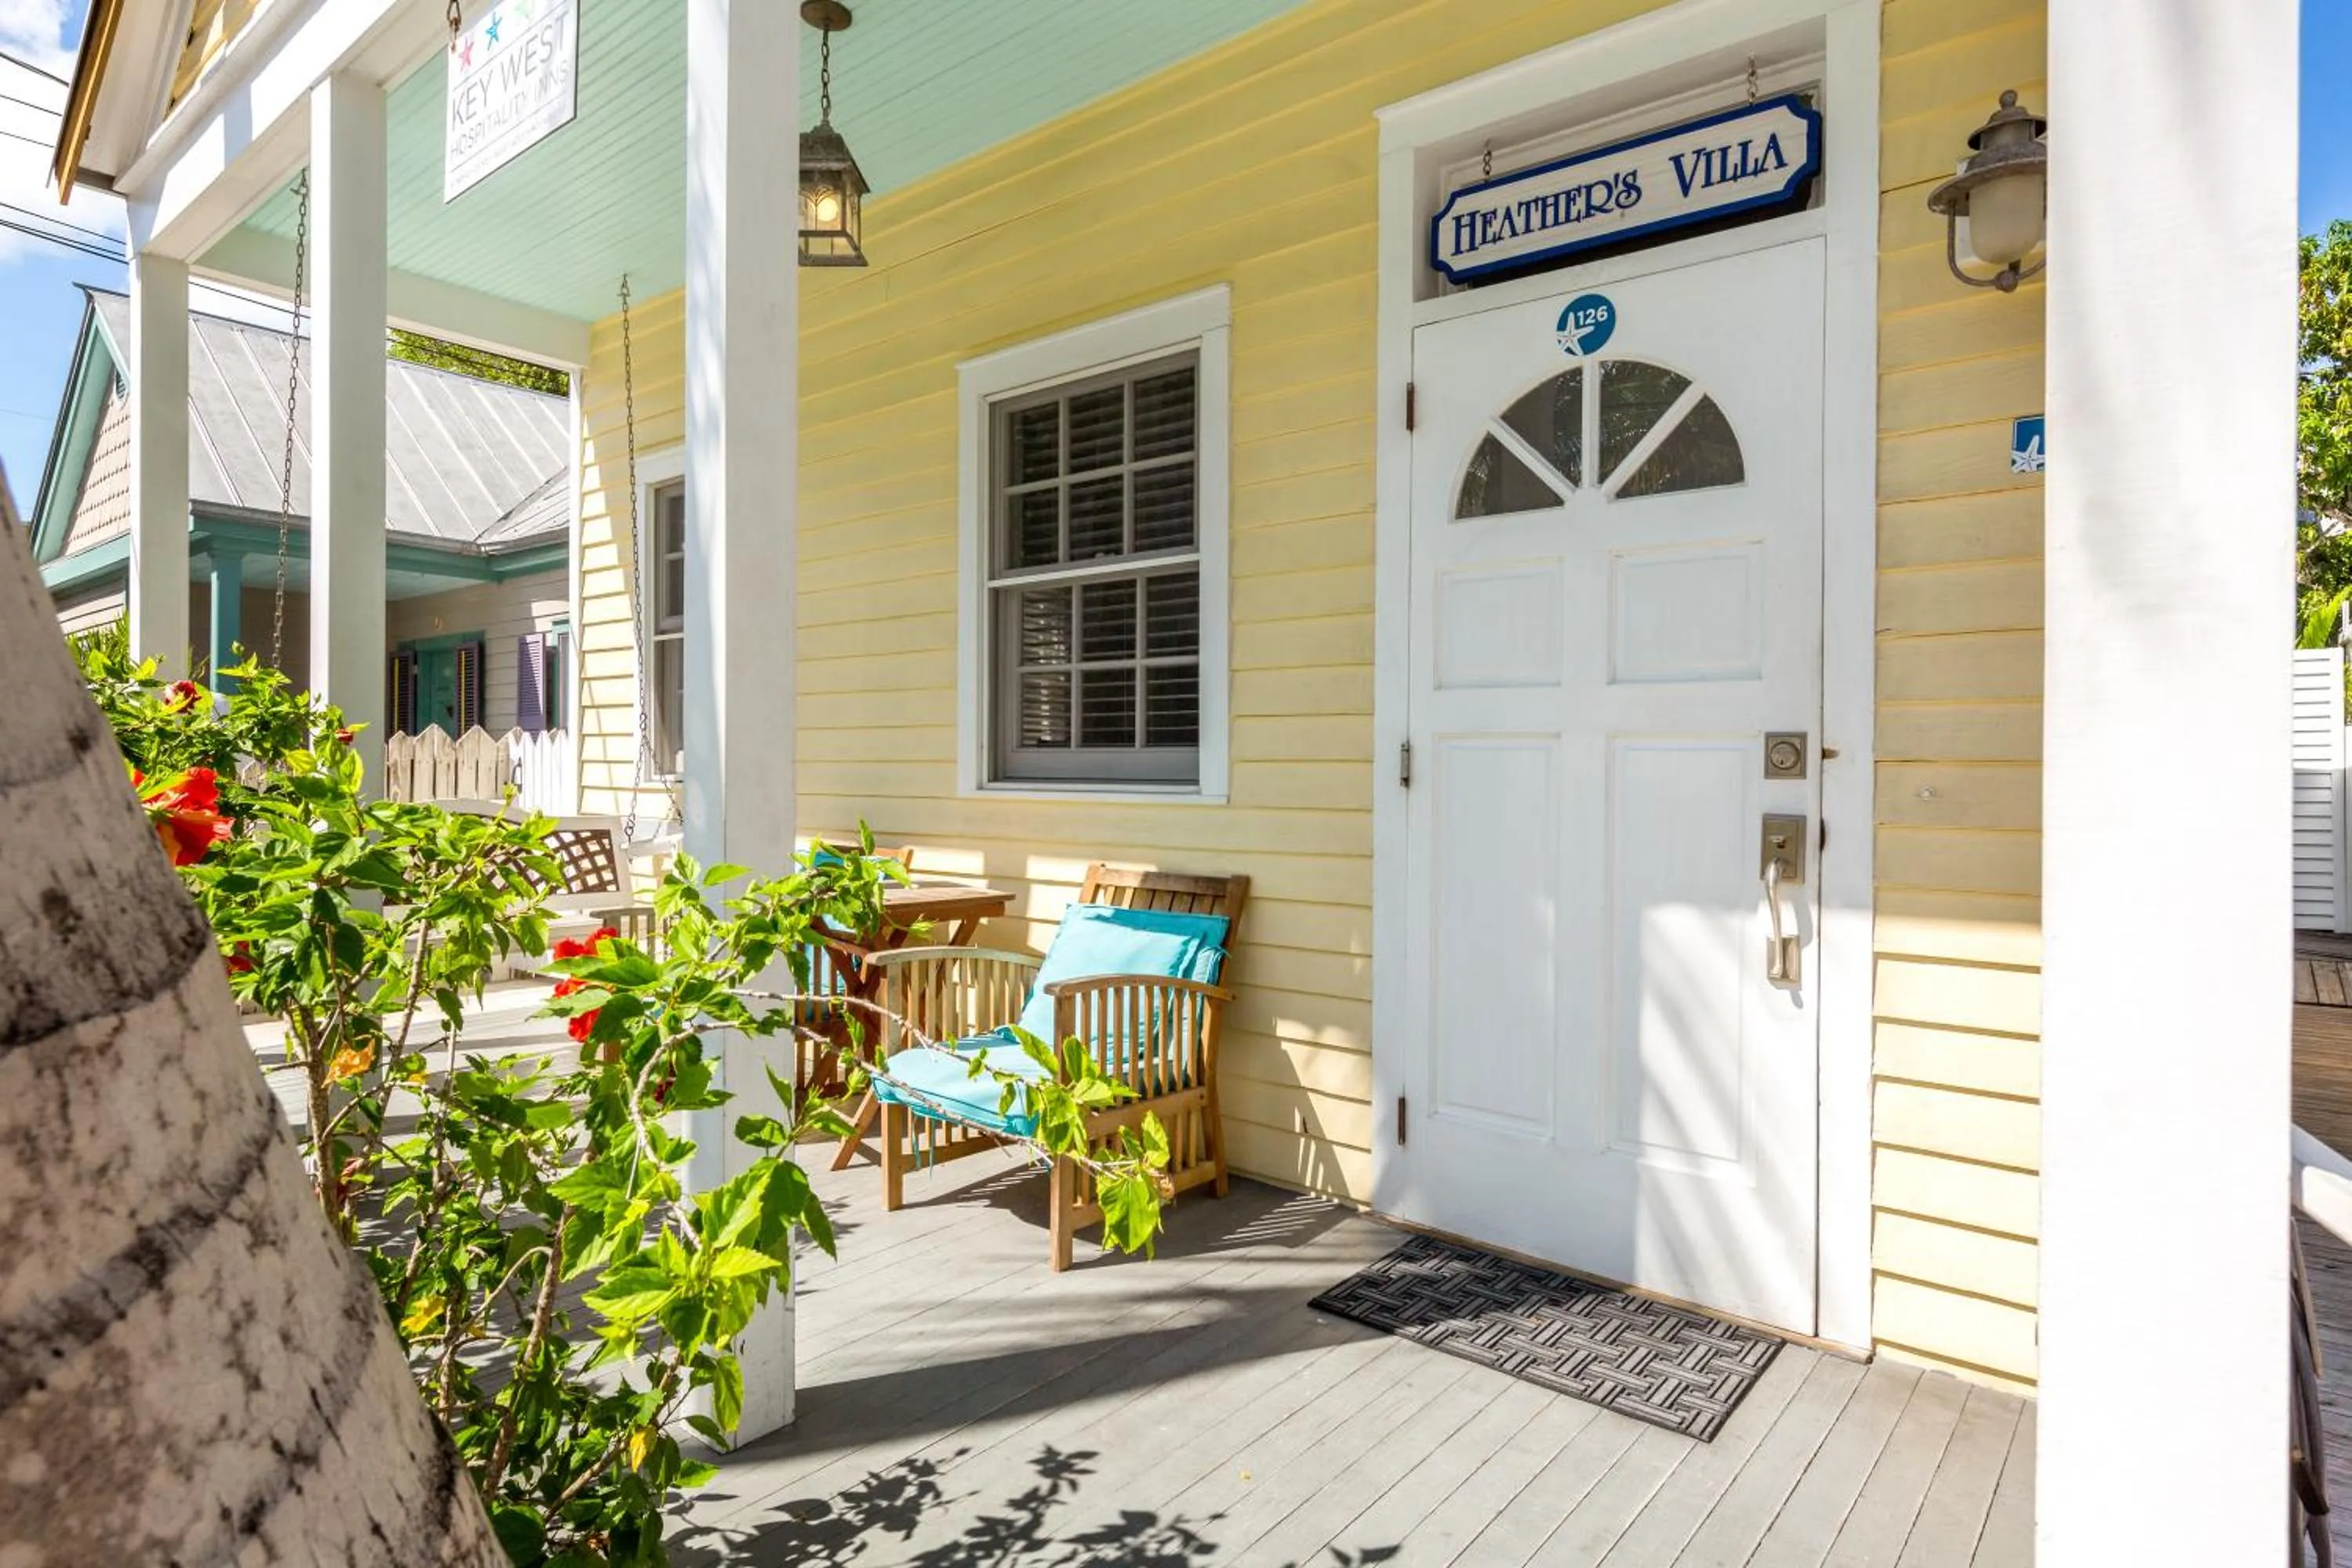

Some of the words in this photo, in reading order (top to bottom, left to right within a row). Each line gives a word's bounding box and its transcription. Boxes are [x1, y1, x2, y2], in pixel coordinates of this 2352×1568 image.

[451, 90, 528, 156] HOSPITALITY
[534, 59, 568, 103] INNS
[452, 69, 494, 132] KEY
[500, 10, 570, 92] WEST
[1450, 169, 1642, 256] HEATHER'S
[1668, 132, 1788, 198] VILLA
[1577, 305, 1608, 325] 126
